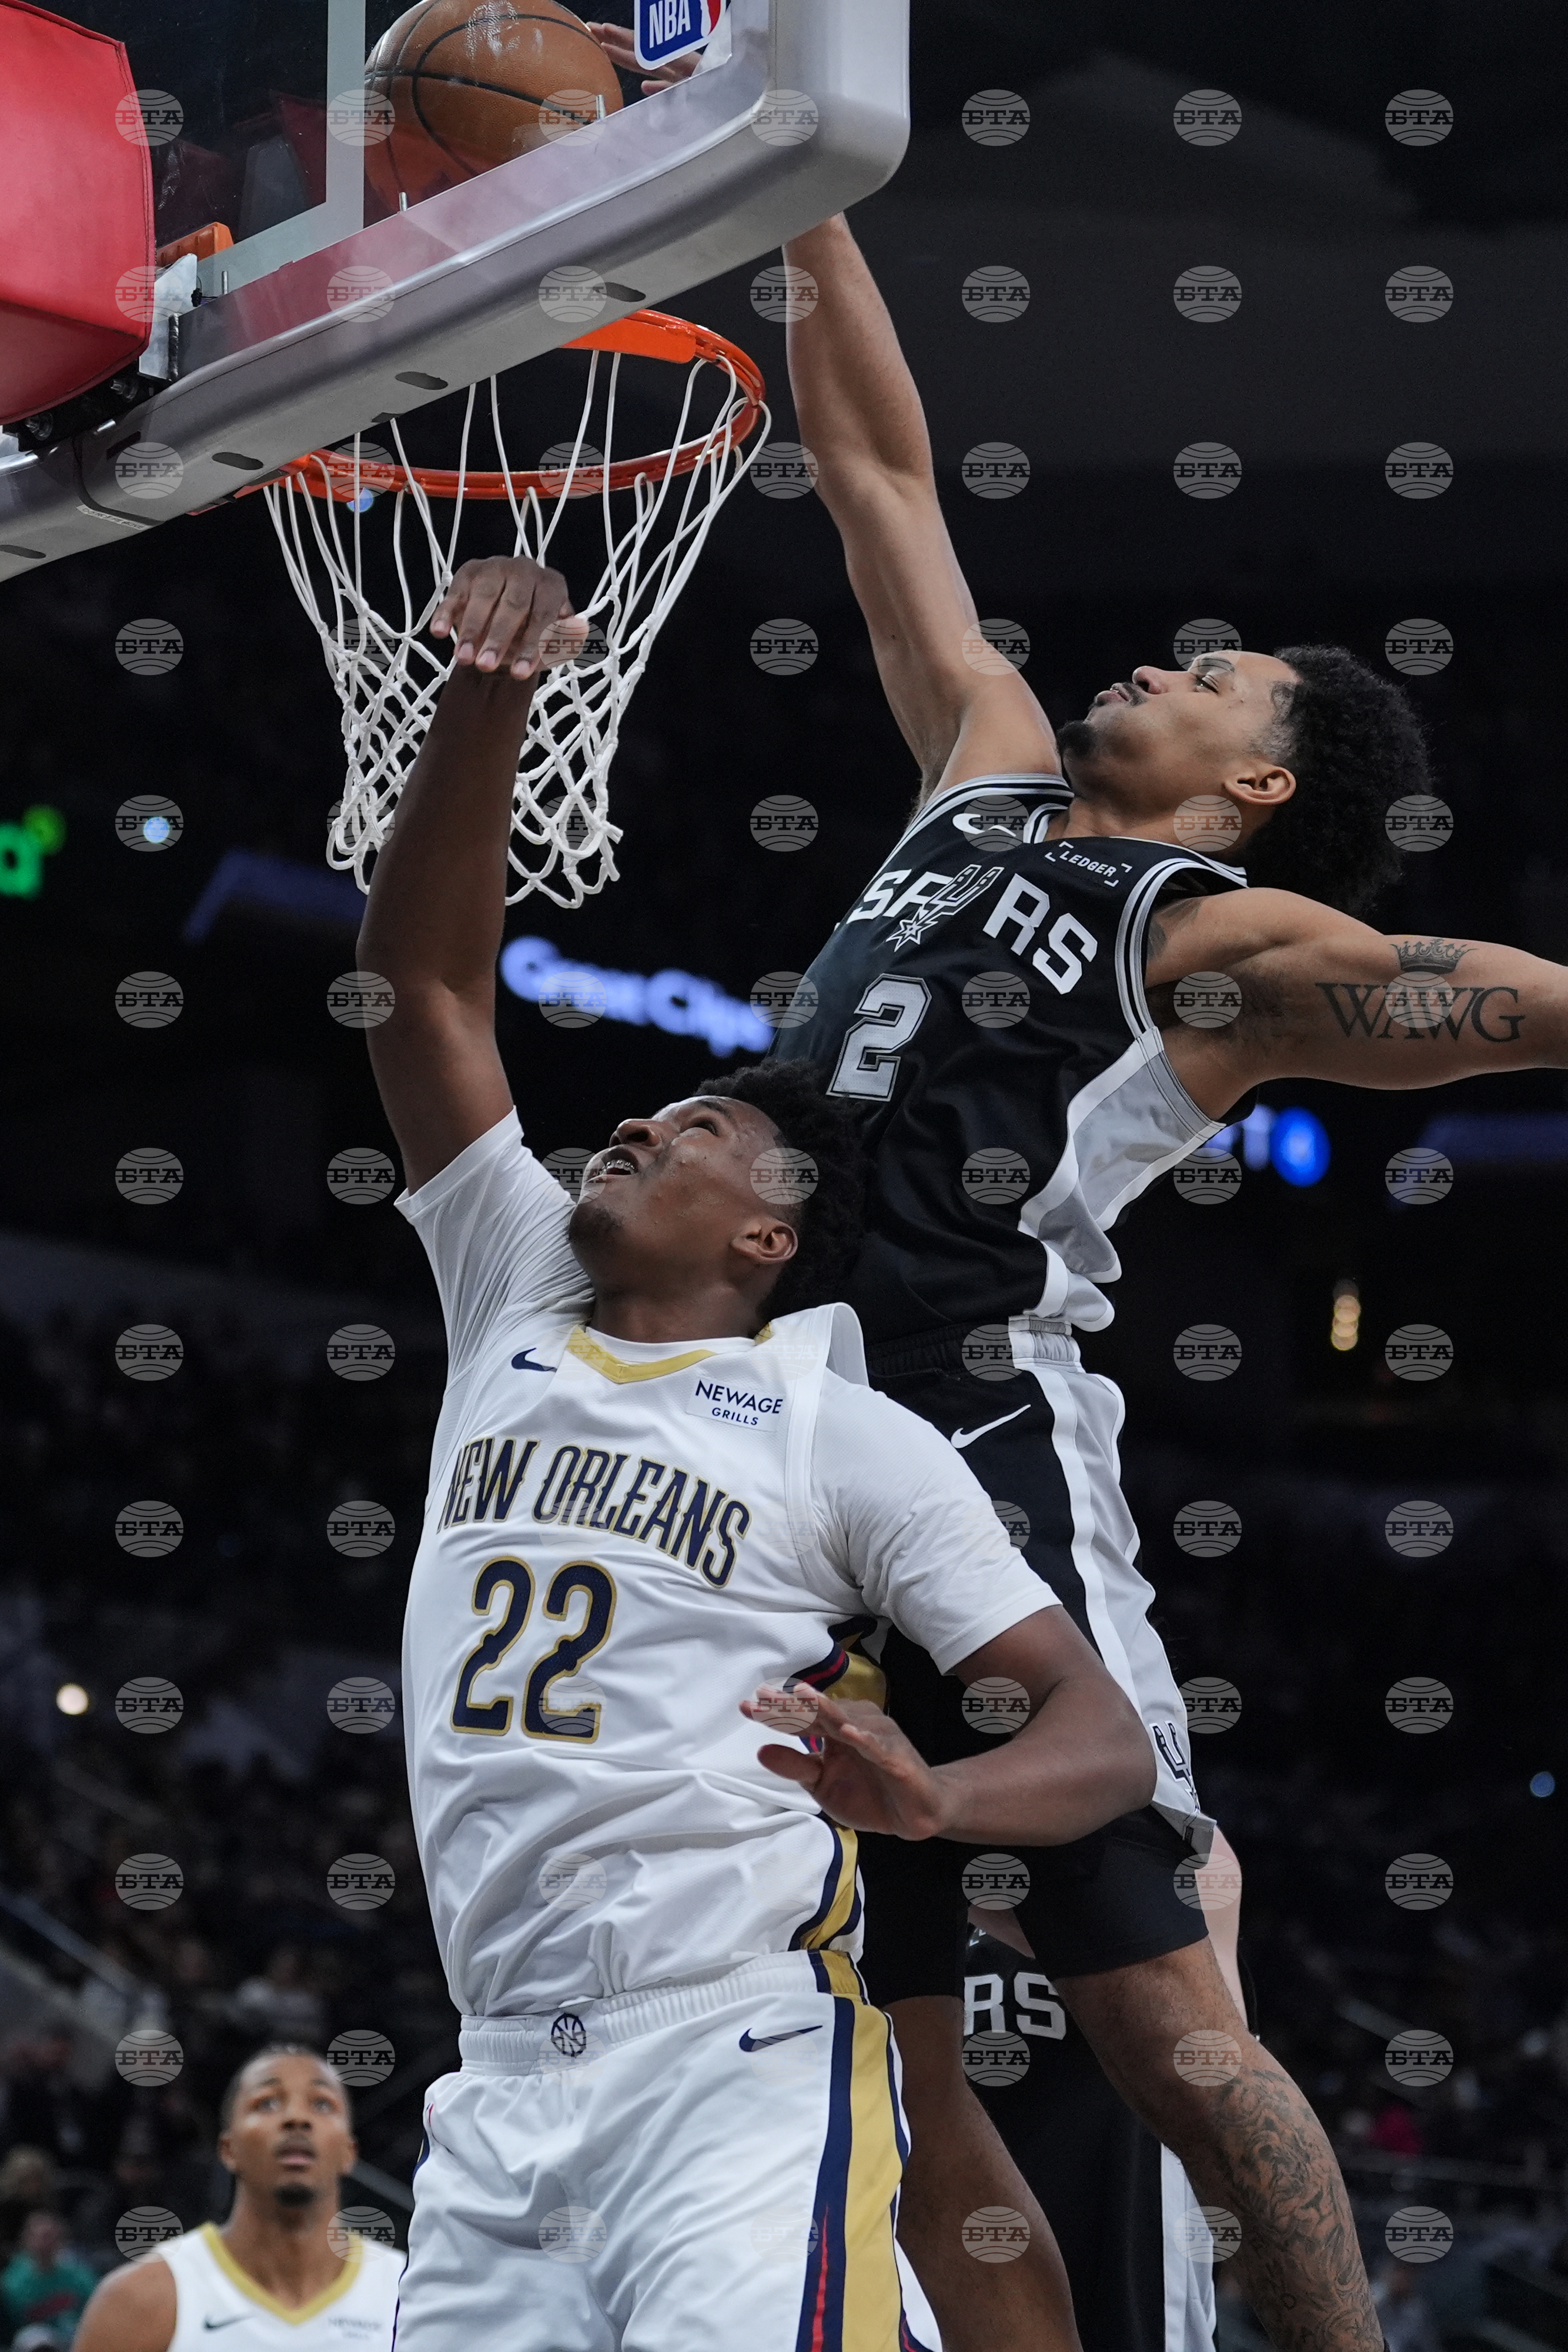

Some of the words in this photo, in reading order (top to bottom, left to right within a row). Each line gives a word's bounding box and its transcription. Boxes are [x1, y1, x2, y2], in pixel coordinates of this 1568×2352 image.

[649, 0, 691, 49] NBA
[1059, 850, 1117, 877] LEDGER
[825, 973, 932, 1102] 2
[1315, 983, 1526, 1043] WAWG
[695, 1379, 783, 1414] NEWAGE
[712, 1407, 758, 1425] GRILLS
[436, 1436, 540, 1535] NEW
[531, 1445, 751, 1589] ORLEANS
[450, 1555, 617, 1744] 22
